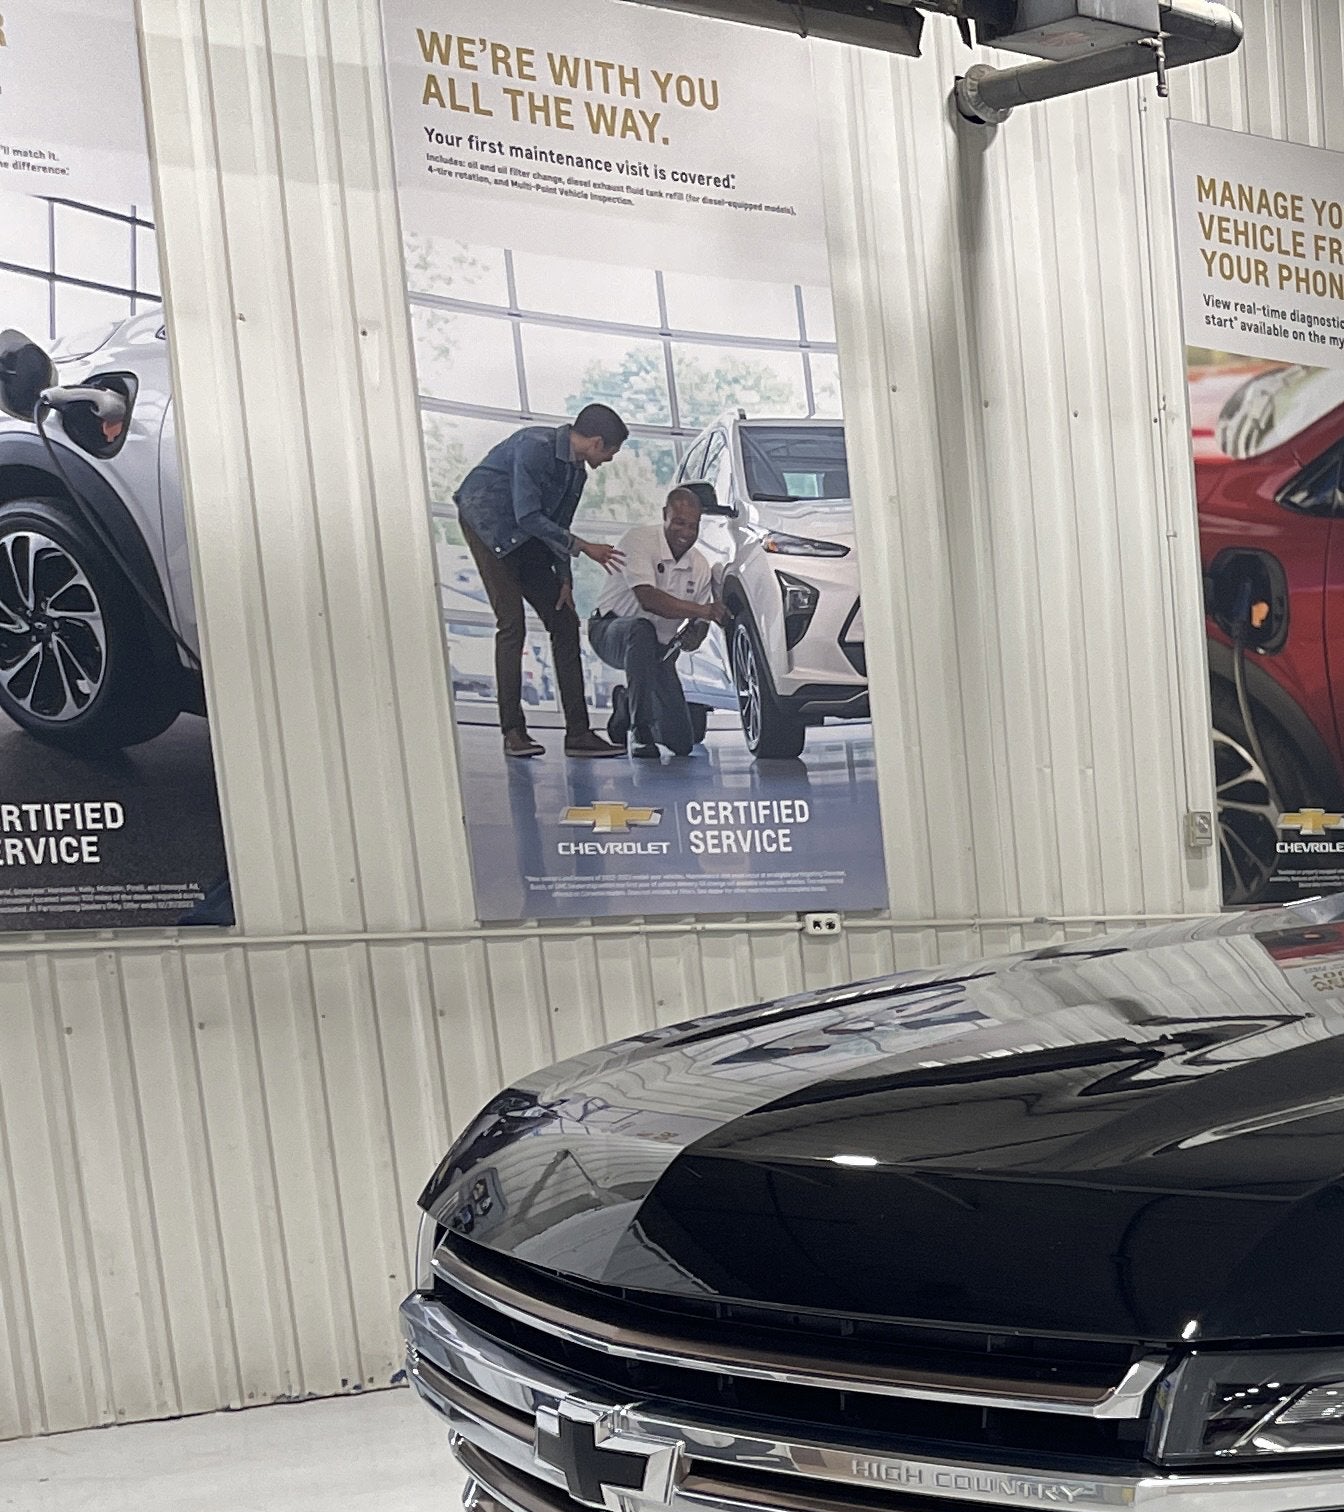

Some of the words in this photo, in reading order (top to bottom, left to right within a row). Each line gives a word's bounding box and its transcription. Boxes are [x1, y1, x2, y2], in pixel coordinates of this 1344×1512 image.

[547, 53, 641, 99] WITH
[650, 70, 719, 111] YOU
[422, 74, 493, 117] ALL
[503, 87, 574, 130] THE
[584, 101, 669, 145] WAY.
[12, 149, 46, 159] match
[424, 126, 463, 150] Your
[467, 134, 505, 156] first
[509, 144, 612, 173] maintenance
[616, 160, 650, 179] visit
[654, 164, 667, 181] is
[426, 153, 466, 168] Includes:
[467, 161, 479, 170] oil
[480, 163, 496, 173] and
[509, 167, 531, 179] filter
[532, 171, 566, 185] change,
[566, 176, 591, 188] diesel
[646, 188, 663, 198] tank
[455, 170, 492, 185] rotation,
[493, 177, 509, 187] and
[511, 180, 557, 195] Multi-Point
[558, 187, 589, 200] Vehicle
[1196, 175, 1305, 223] MANAGE
[1197, 211, 1306, 260] VEHICLE
[1200, 248, 1270, 288] YOUR
[1203, 293, 1231, 311] View
[1234, 299, 1287, 321] real-time
[1240, 320, 1289, 339] available
[1292, 330, 1306, 342] on
[1308, 330, 1326, 345] the
[0, 802, 125, 832] RTIFIED
[686, 800, 809, 826] CERTIFIED
[0, 836, 100, 866] RVICE
[557, 841, 671, 856] CHEVROLET
[688, 828, 792, 855] SERVICE
[851, 1458, 923, 1485] HIGH
[934, 1471, 1084, 1503] COUNTRY
